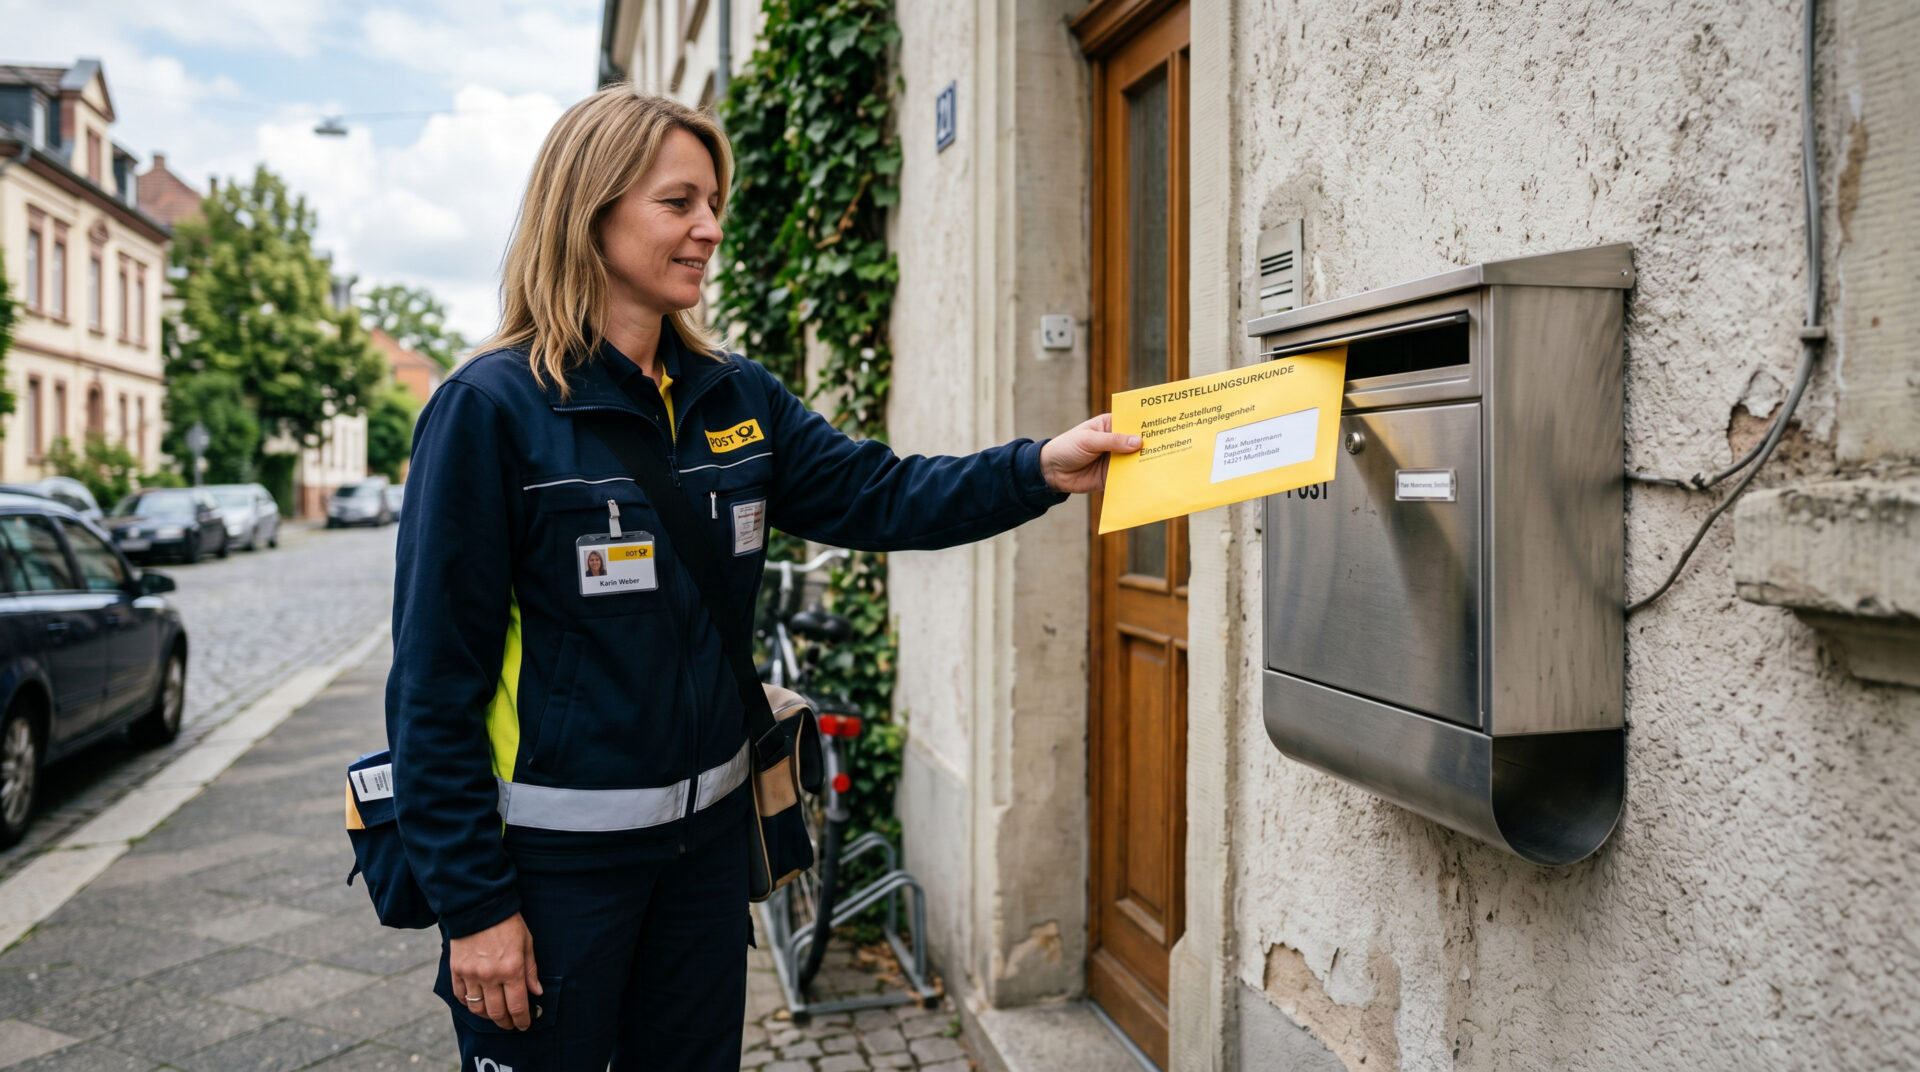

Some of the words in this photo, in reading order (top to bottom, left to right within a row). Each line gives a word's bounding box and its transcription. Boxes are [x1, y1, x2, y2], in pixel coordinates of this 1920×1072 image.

[1140, 365, 1295, 407] POSTZUSTELLUNGSURKUNDE
[1141, 416, 1177, 429] Amtliche
[1179, 405, 1222, 420] Zustellung
[709, 434, 734, 447] POST
[1140, 438, 1192, 456] Einschreiben
[1240, 433, 1282, 446] Mustermann
